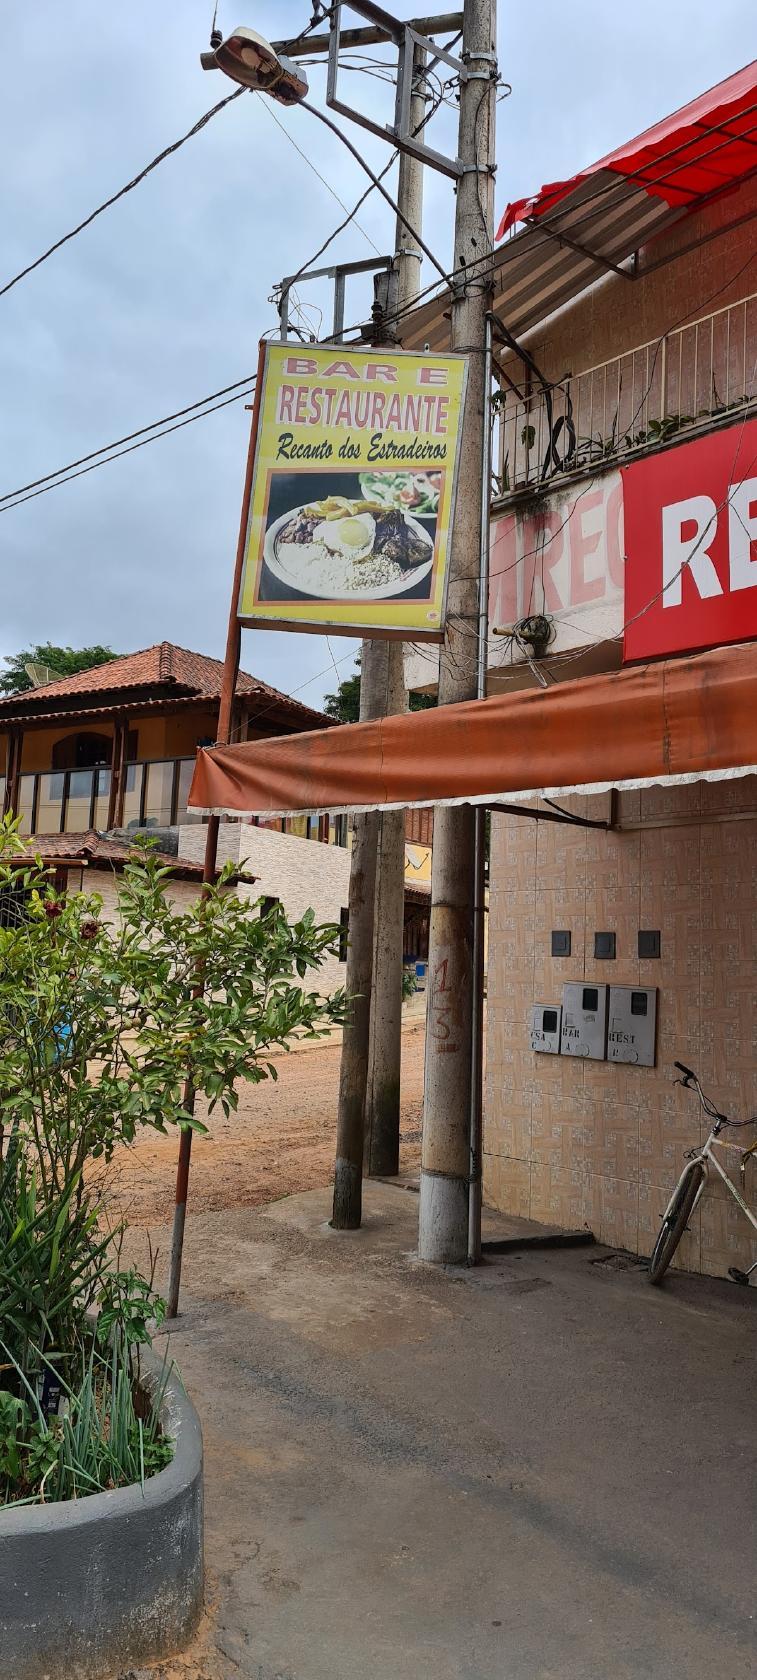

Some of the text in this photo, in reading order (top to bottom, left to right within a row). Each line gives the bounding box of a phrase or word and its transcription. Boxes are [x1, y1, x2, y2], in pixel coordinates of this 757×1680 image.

[285, 357, 449, 386] BAR E
[276, 384, 450, 435] RESTAURANTE
[276, 432, 447, 462] Recanto dos Estradeiros
[562, 1027, 580, 1039] BAR
[609, 1032, 635, 1044] REST
